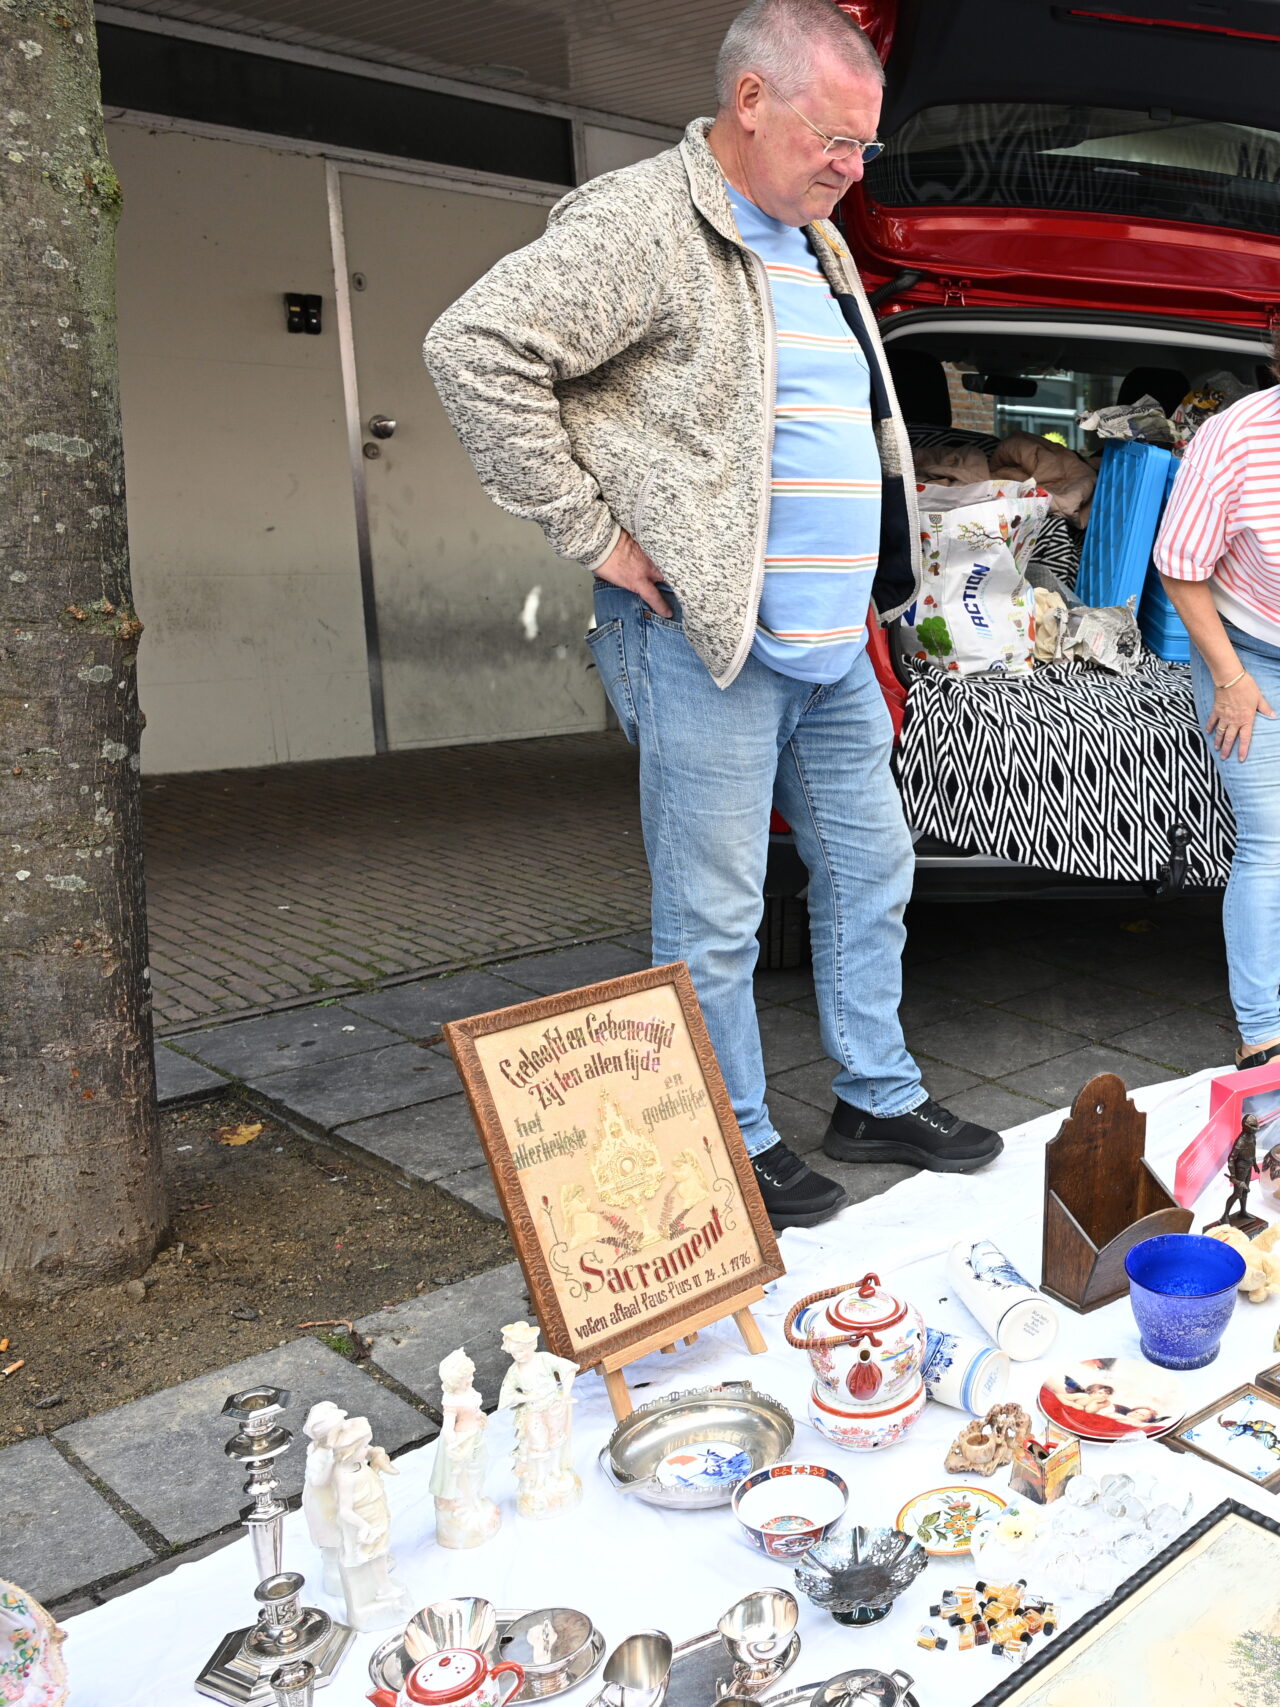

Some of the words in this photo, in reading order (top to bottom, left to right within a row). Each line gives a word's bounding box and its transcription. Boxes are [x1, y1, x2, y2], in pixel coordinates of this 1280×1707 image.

[962, 562, 991, 628] ACTION
[565, 1026, 588, 1051] en
[584, 1010, 677, 1055] Gebenedijd
[528, 1076, 567, 1111] Zij
[555, 1067, 584, 1093] ten
[583, 1052, 624, 1080] allen
[622, 1046, 662, 1082] tijde
[663, 1072, 685, 1090] en
[513, 1110, 545, 1138] het
[641, 1085, 707, 1133] goddelijke
[578, 1204, 725, 1297] Sacrament
[640, 1290, 668, 1312] Paus
[666, 1277, 693, 1301] Pius
